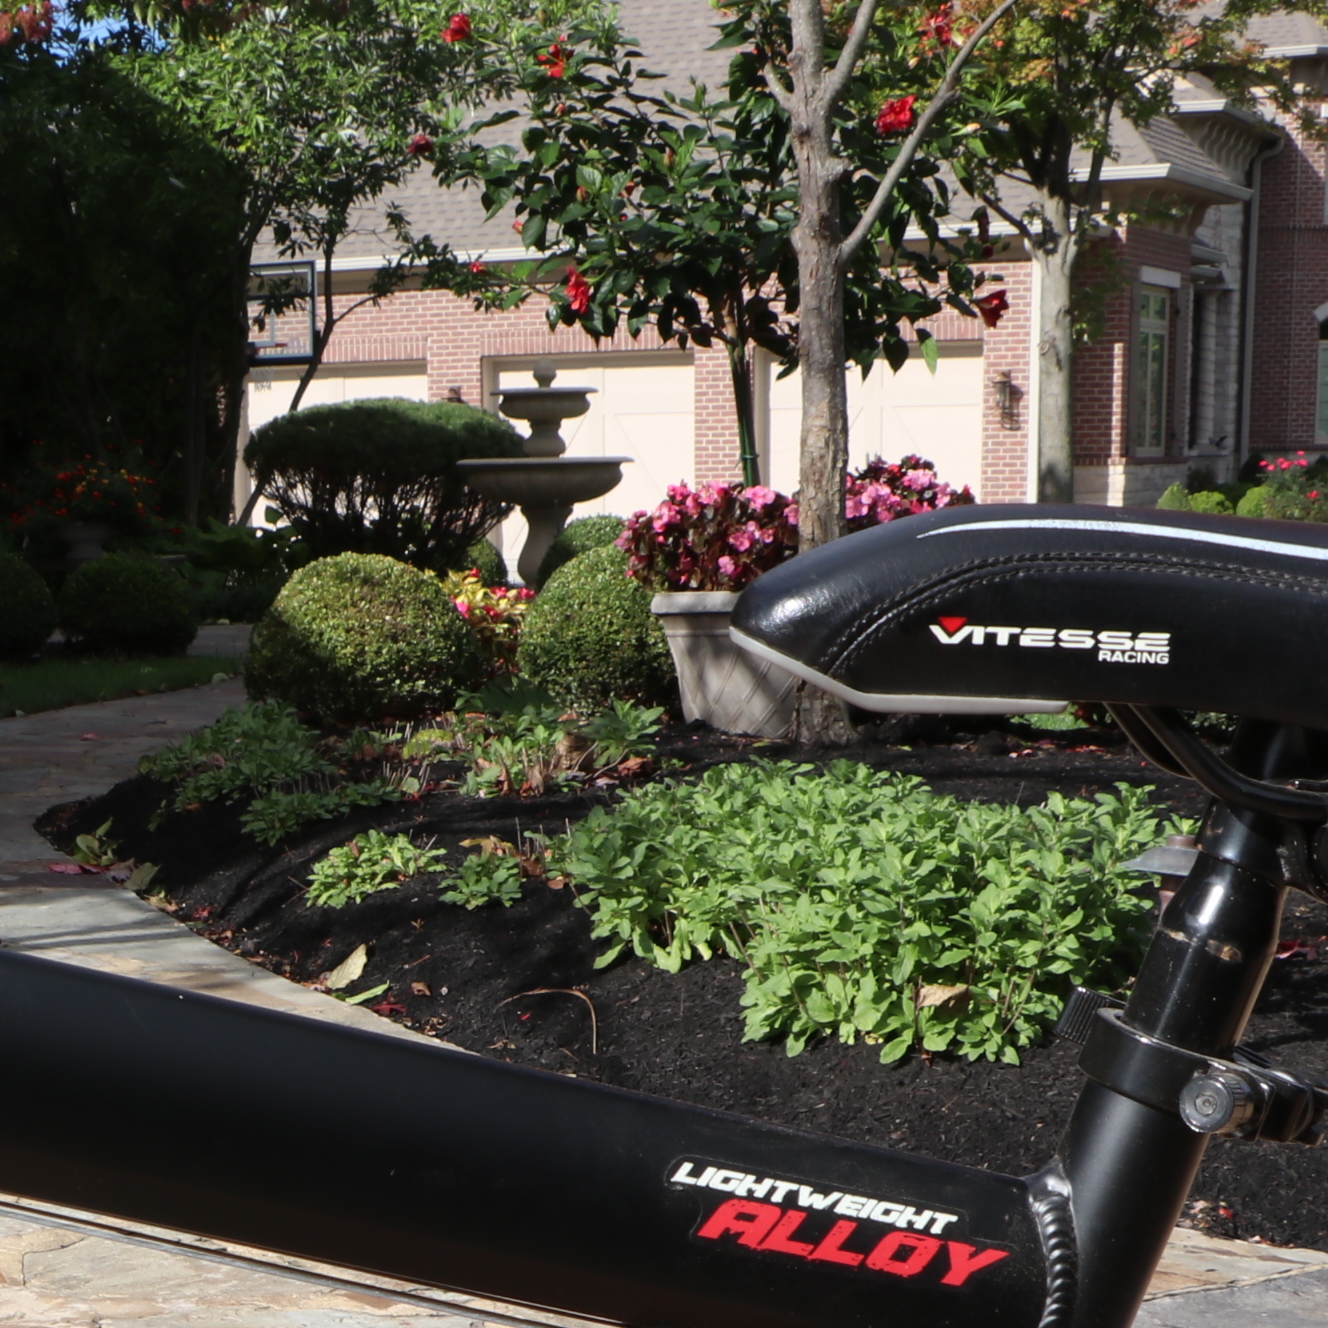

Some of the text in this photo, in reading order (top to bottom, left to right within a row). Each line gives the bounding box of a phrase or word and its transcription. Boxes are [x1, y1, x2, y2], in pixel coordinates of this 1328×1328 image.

[929, 622, 1171, 651] VITESSE
[1098, 650, 1170, 664] RACING
[670, 1161, 959, 1235] LIGHTWEIGHT
[697, 1197, 1010, 1287] ALLOY
